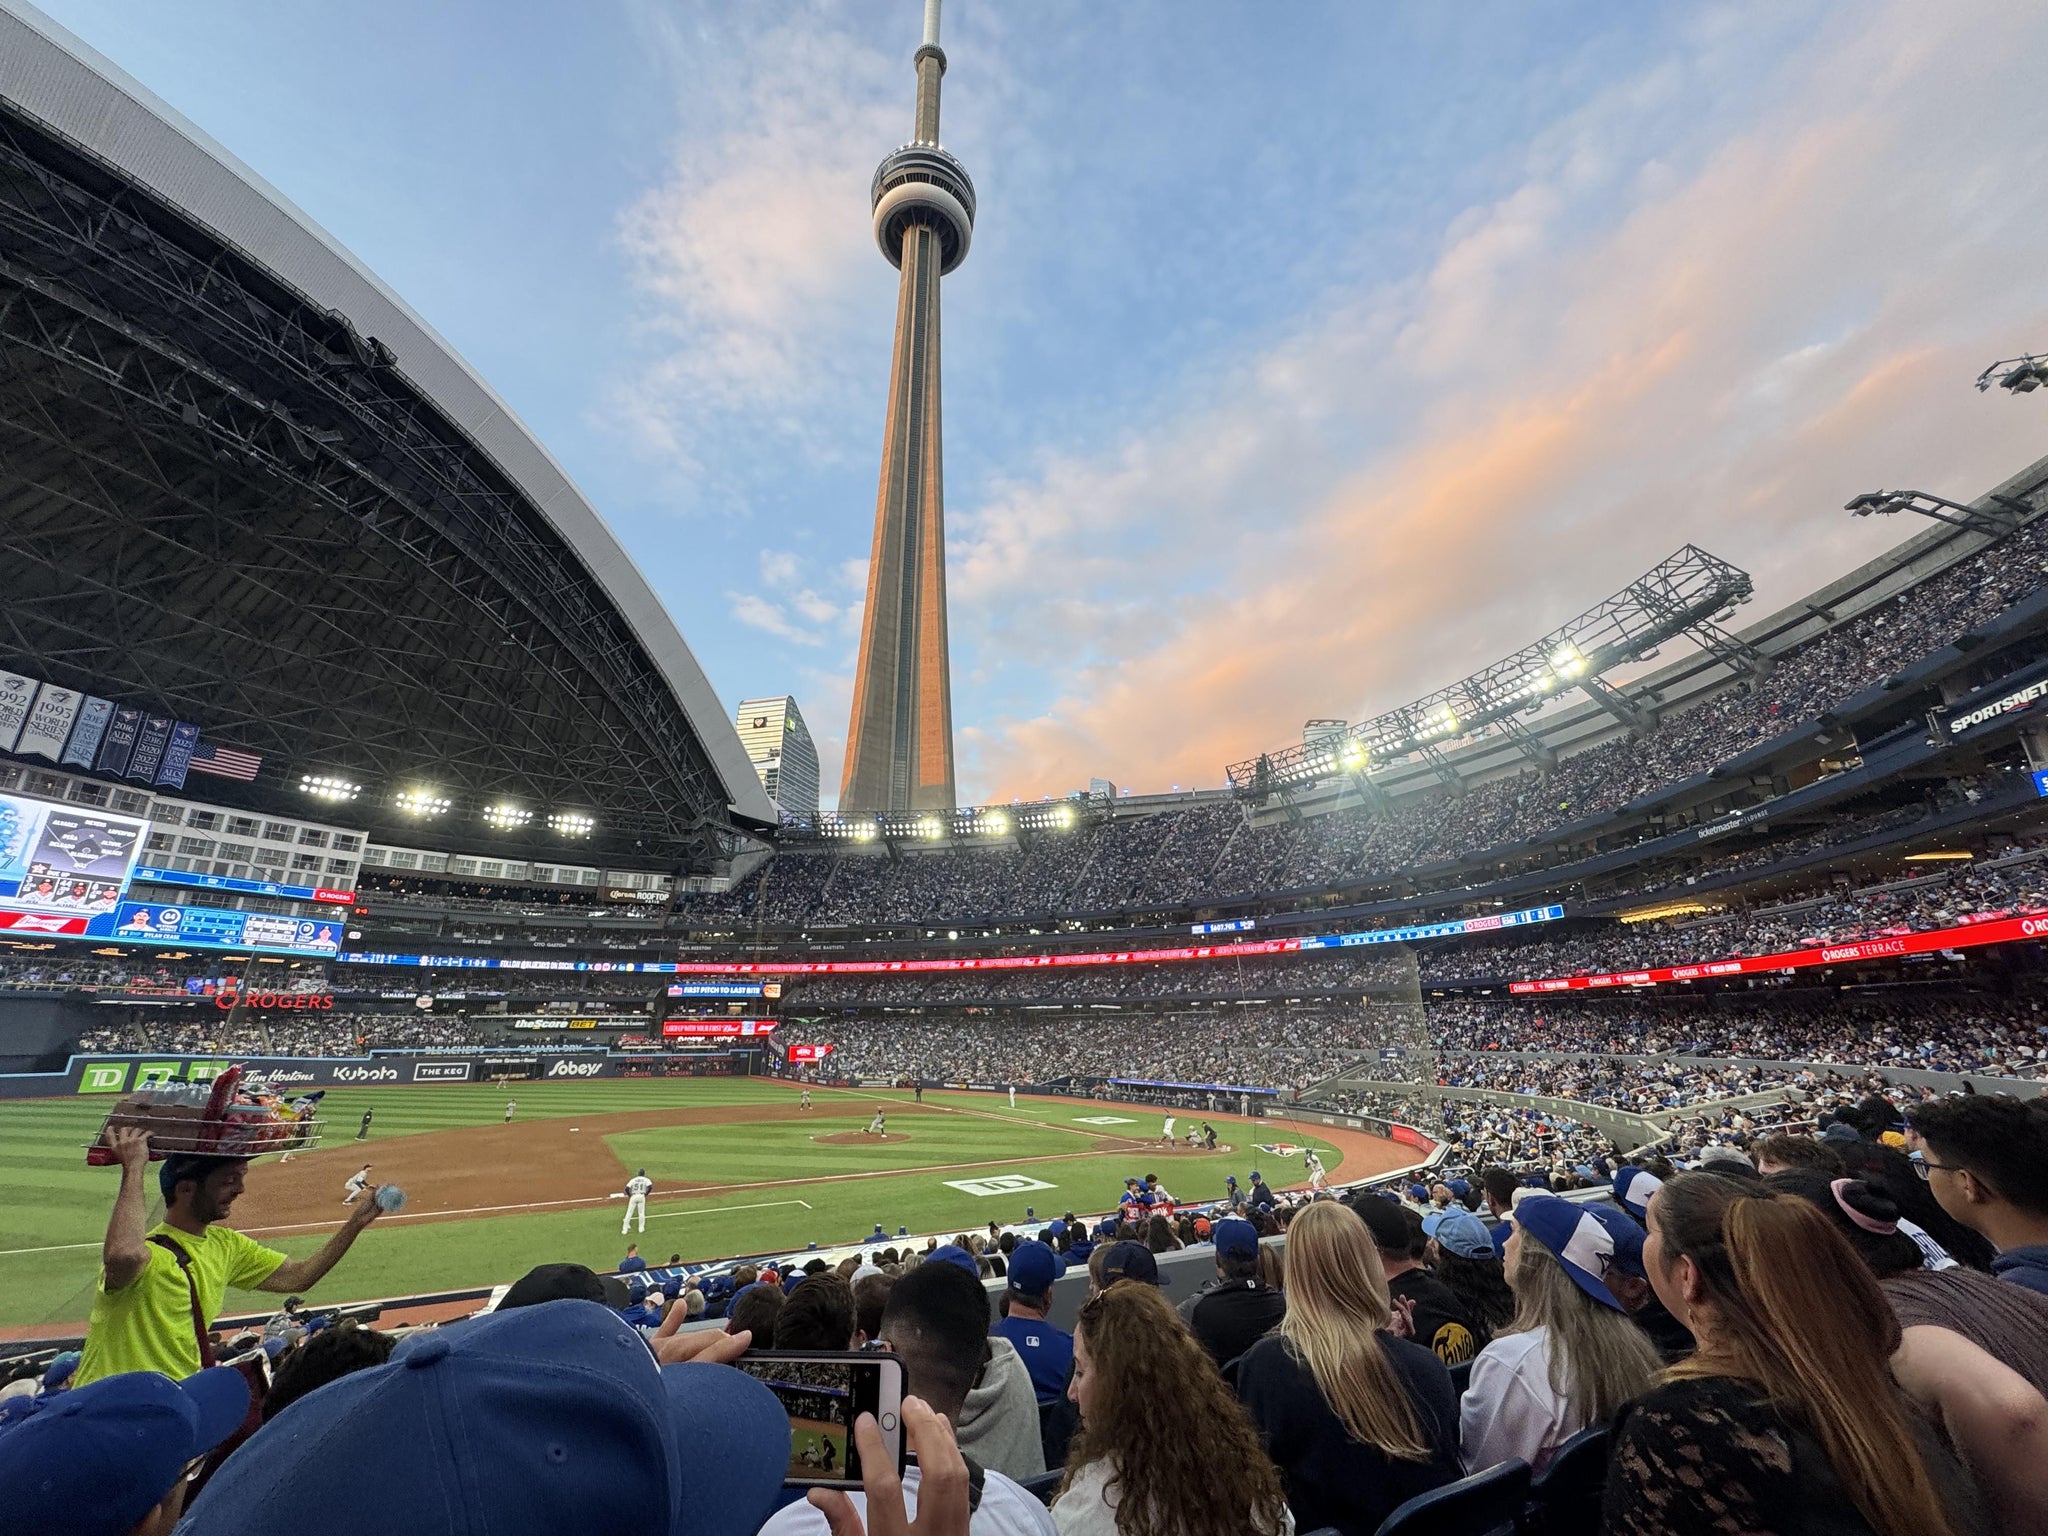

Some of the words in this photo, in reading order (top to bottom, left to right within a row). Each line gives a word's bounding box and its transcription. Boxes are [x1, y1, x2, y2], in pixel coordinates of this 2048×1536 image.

[40, 702, 72, 719] 1993
[1951, 679, 2048, 733] SPORTSNET
[35, 713, 69, 728] WORLD
[30, 721, 65, 735] SERIES
[115, 722, 134, 733] 2016
[111, 731, 132, 741] ALDS
[140, 744, 160, 754] 2020
[174, 738, 193, 748] 2025
[136, 754, 157, 764] 2022
[1698, 819, 1740, 838] ticketmaster
[1748, 809, 1768, 822] LOUNGE
[637, 892, 669, 901] ROOFTOP
[1475, 917, 1499, 929] ROGERS
[1830, 949, 1859, 960] ROGERS
[1860, 940, 1905, 955] TERRACE
[500, 960, 521, 968] FOLLOW
[1679, 968, 1699, 977] ROGERS
[1518, 983, 1534, 991] ROGERS
[1594, 977, 1612, 985] ROGERS
[245, 993, 334, 1010] ROGERS
[515, 1019, 568, 1029] theScore
[571, 1021, 595, 1029] BET
[333, 1066, 398, 1080] Kubota
[549, 1060, 603, 1076] Sobeys
[89, 1068, 122, 1087] TD
[245, 1070, 267, 1083] Tim
[267, 1068, 314, 1083] Hortons
[959, 1179, 1036, 1191] TD
